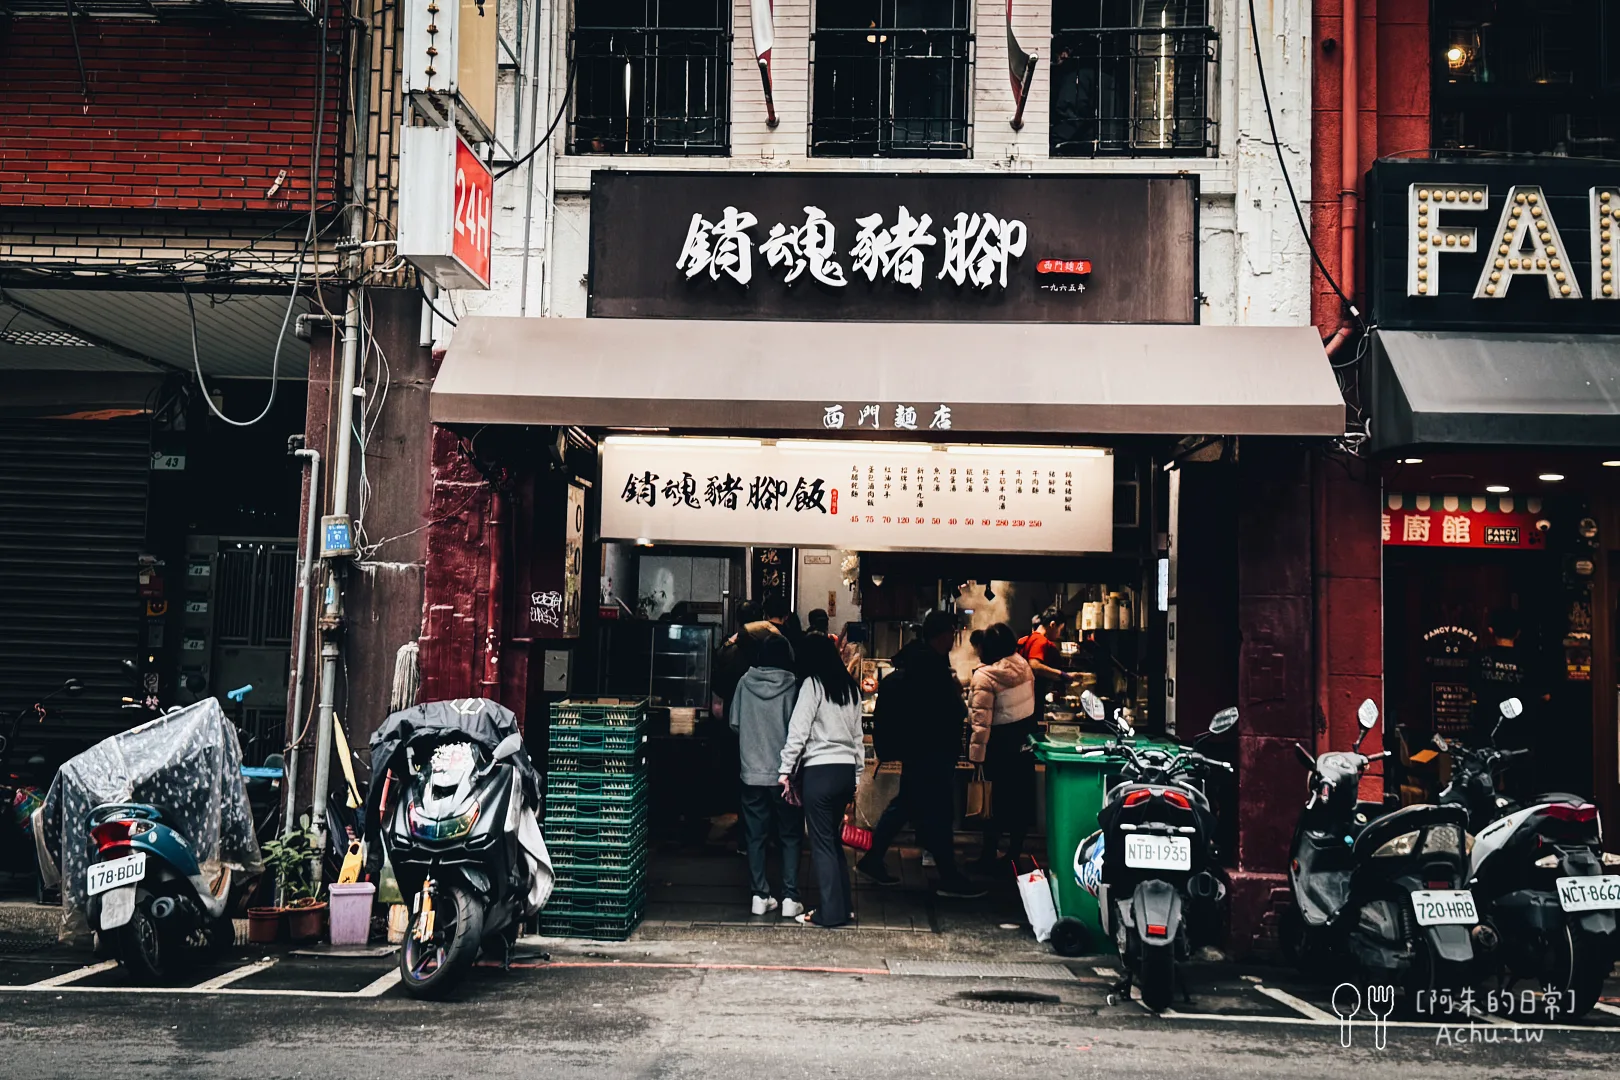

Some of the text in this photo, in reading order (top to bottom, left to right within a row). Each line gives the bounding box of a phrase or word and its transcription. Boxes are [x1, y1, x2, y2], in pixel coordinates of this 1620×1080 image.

[455, 168, 490, 257] 24H
[675, 205, 1027, 290] 銷魂豬腳
[1040, 283, 1086, 294] 一九六五年
[822, 403, 953, 431] 西門麵店
[165, 457, 178, 468] 43
[620, 471, 827, 514] 銷魂豬腳飯
[850, 515, 859, 523] 45
[865, 515, 874, 523] 75
[882, 516, 891, 524] 70
[897, 516, 910, 524] 120
[915, 517, 925, 525] 50
[931, 517, 941, 525] 50
[1012, 519, 1026, 527] 230
[1029, 520, 1042, 528] 250
[1423, 625, 1478, 643] FANCY PASTA
